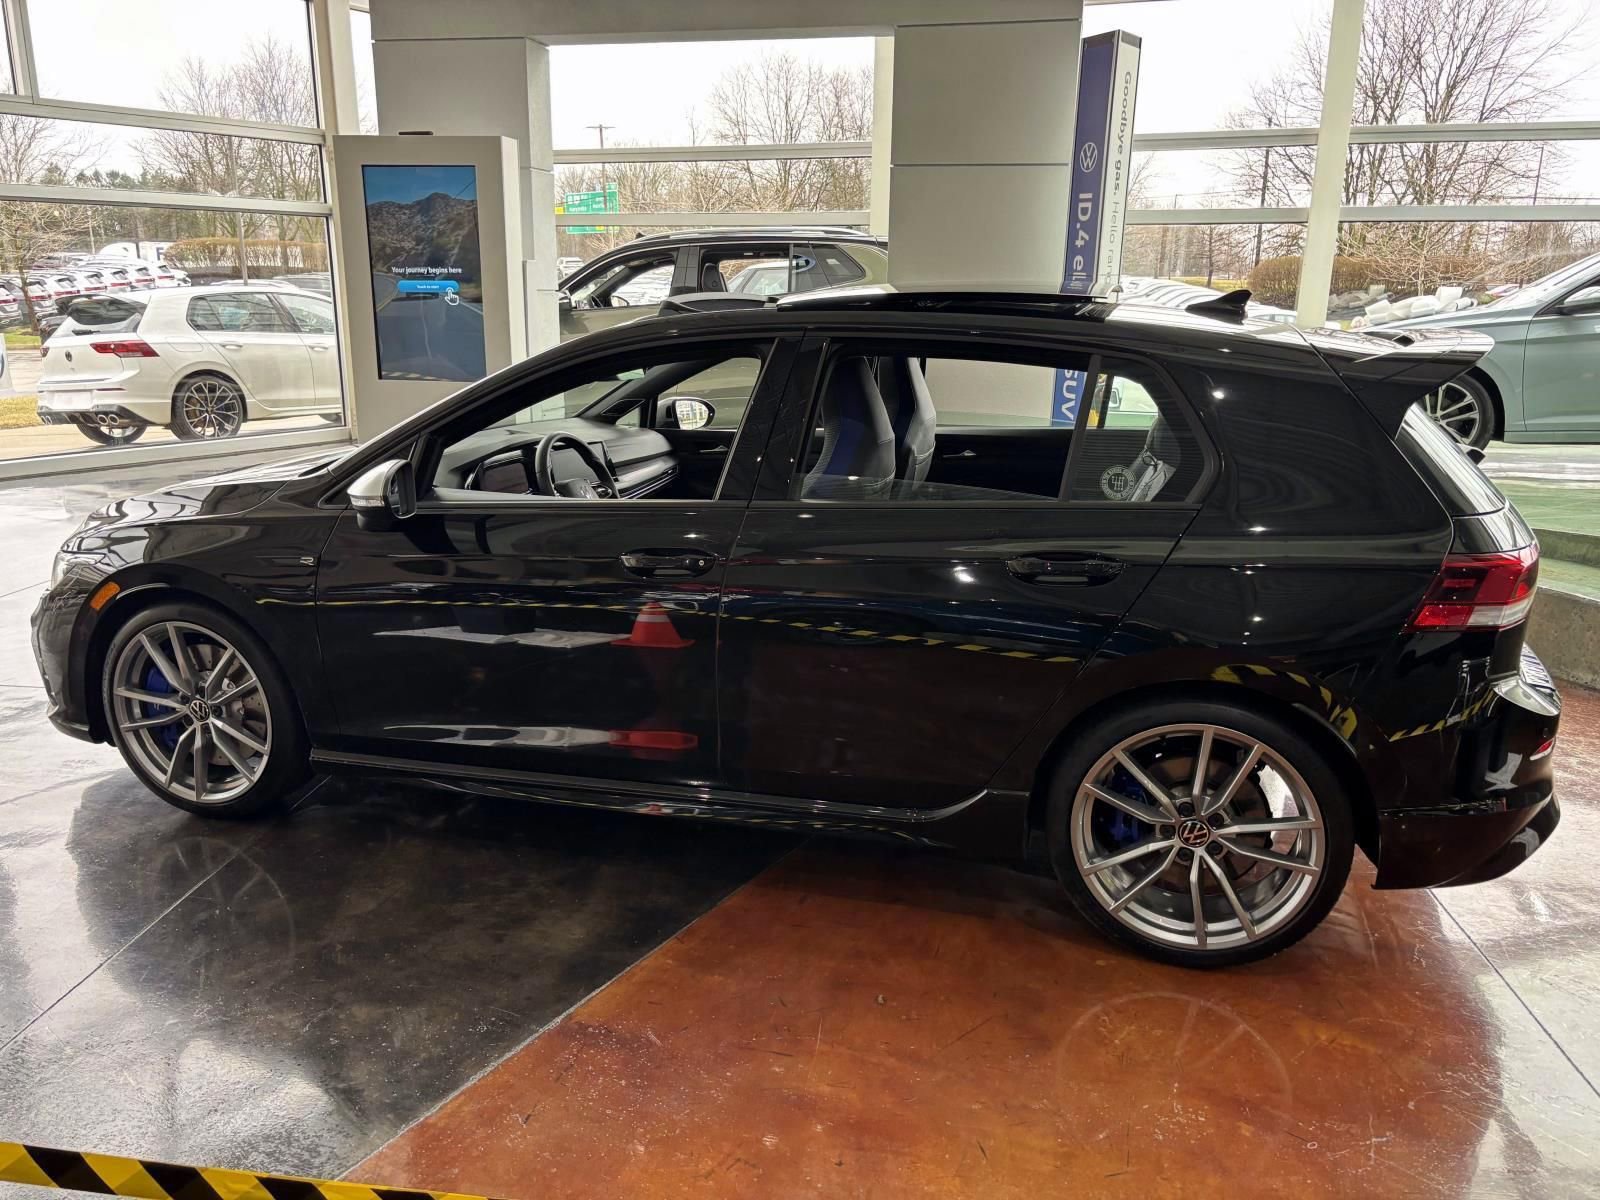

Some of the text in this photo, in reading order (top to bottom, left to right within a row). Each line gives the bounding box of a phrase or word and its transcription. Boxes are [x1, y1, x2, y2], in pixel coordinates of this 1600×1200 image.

[1117, 71, 1132, 155] Goodbye
[1112, 160, 1121, 196] gas.
[1074, 192, 1093, 248] ID.4
[1109, 202, 1121, 244] Hello
[405, 266, 428, 275] journey
[428, 266, 448, 275] begins
[448, 266, 462, 274] here
